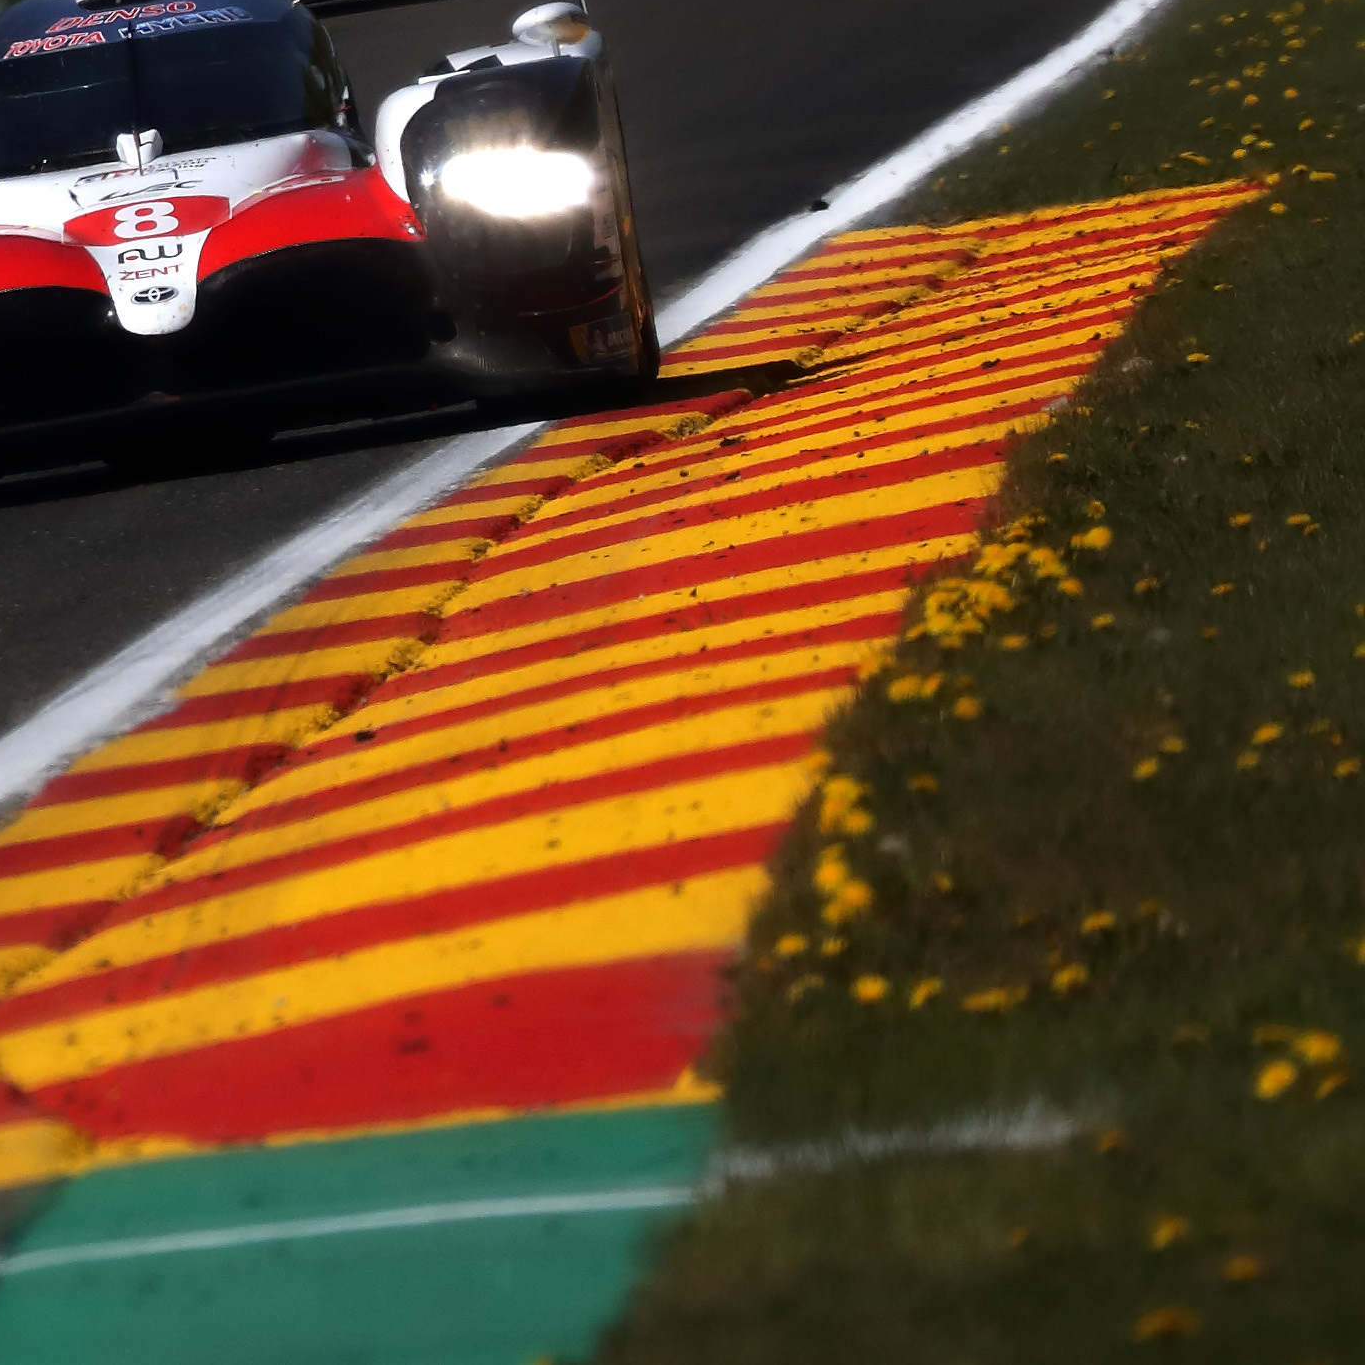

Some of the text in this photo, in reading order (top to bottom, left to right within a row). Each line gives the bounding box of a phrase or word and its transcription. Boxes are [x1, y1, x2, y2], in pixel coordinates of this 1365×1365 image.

[45, 1, 197, 34] DENSO
[3, 30, 106, 59] TOYOTA
[114, 201, 180, 239] 8
[118, 263, 185, 281] ZENT
